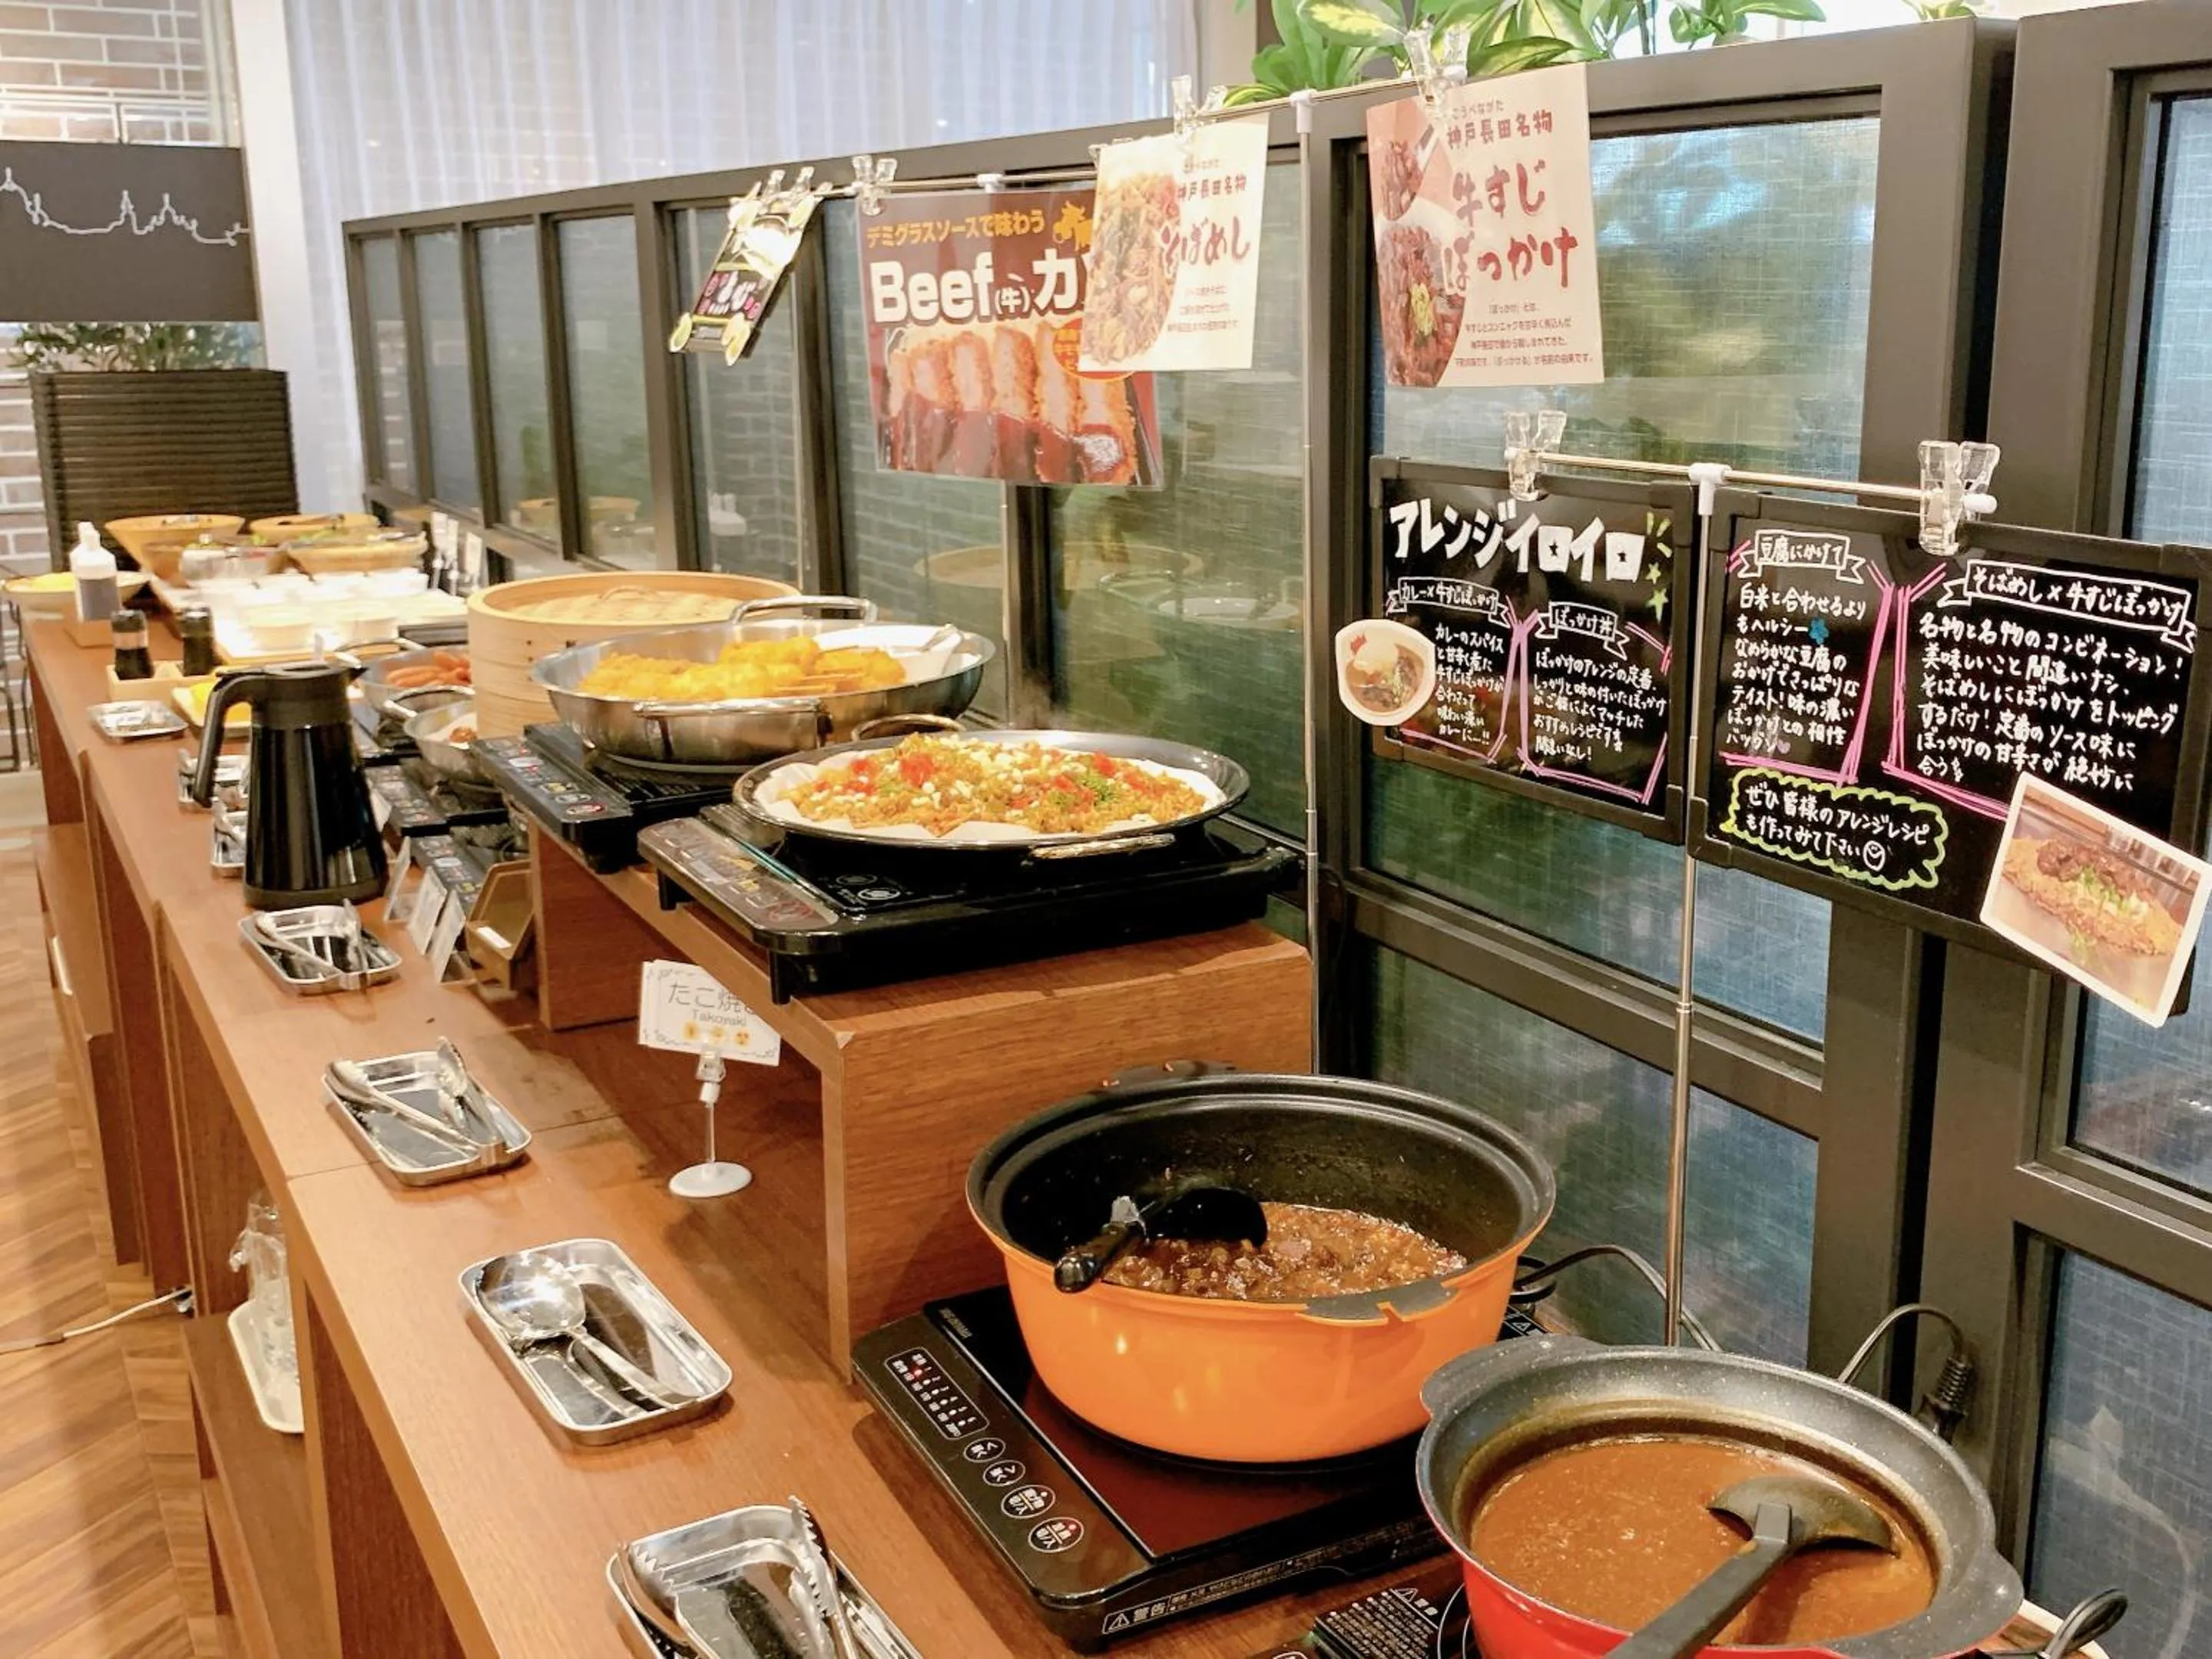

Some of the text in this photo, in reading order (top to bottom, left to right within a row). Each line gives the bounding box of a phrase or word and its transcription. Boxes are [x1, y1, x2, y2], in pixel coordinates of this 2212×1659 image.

[1447, 109, 1552, 150] 神戸長田名物
[1452, 159, 1545, 227] 牛すじ
[867, 210, 1045, 248] デミグラスソースで味わう
[1161, 216, 1251, 272] そばめし
[1442, 227, 1578, 293] ぼっかけ
[869, 248, 1091, 323] Beef(牛)カ
[1389, 498, 1645, 582] アレンジイロイロ
[1760, 535, 1843, 566] 豆腐にかけて
[1740, 581, 1866, 621] 白米と合わせるより
[1435, 622, 1504, 654] カレーのスパイス
[1736, 614, 1809, 637] もヘルシー
[1735, 637, 1847, 673] なめらかな豆腐の
[1435, 684, 1476, 711] 合わさって
[1534, 674, 1667, 717] しっかりと味の付いたぼっかけ
[1732, 661, 1860, 698] おかげでさっぱりな
[1533, 690, 1644, 730] がご飯によくマッチした
[1921, 673, 2179, 734] そばめしにぼっかけをトッピング
[1728, 704, 1846, 746] ぼっかけとの相性
[1917, 726, 2133, 792] ぼっかけの甘辛さが絶妙に
[1745, 780, 1930, 845] ぜひ皆様のアレンジレシピ
[1746, 813, 1861, 857] も作ってみて下さい
